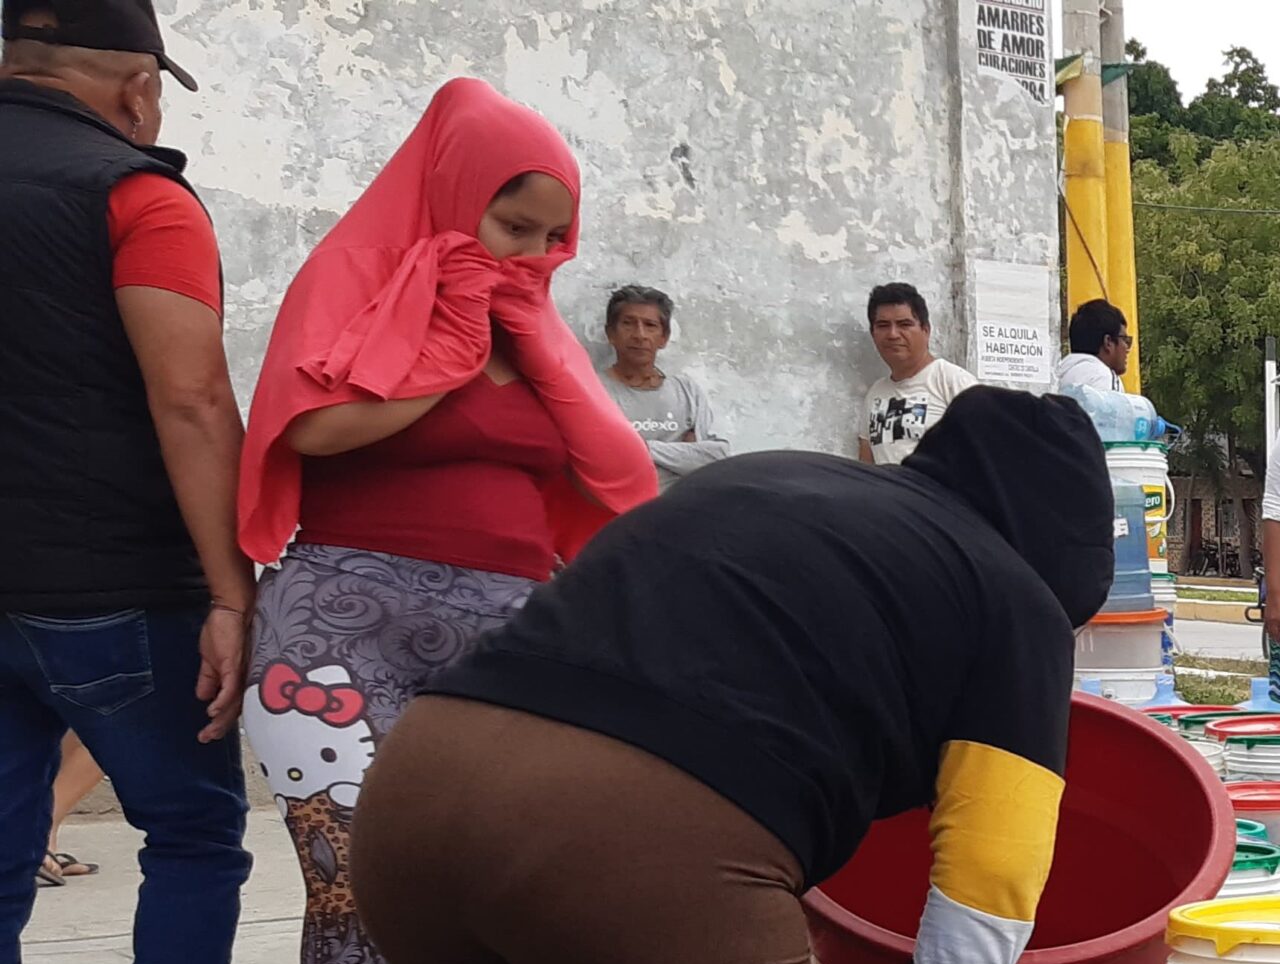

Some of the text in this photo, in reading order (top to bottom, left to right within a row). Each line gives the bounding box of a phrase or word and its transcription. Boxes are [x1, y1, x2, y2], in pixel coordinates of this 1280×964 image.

[977, 4, 1045, 36] AMARRES
[977, 28, 1045, 59] DE AMOR
[982, 325, 1038, 341] SE ALQUILA
[985, 342, 1043, 356] HABITACIÓN
